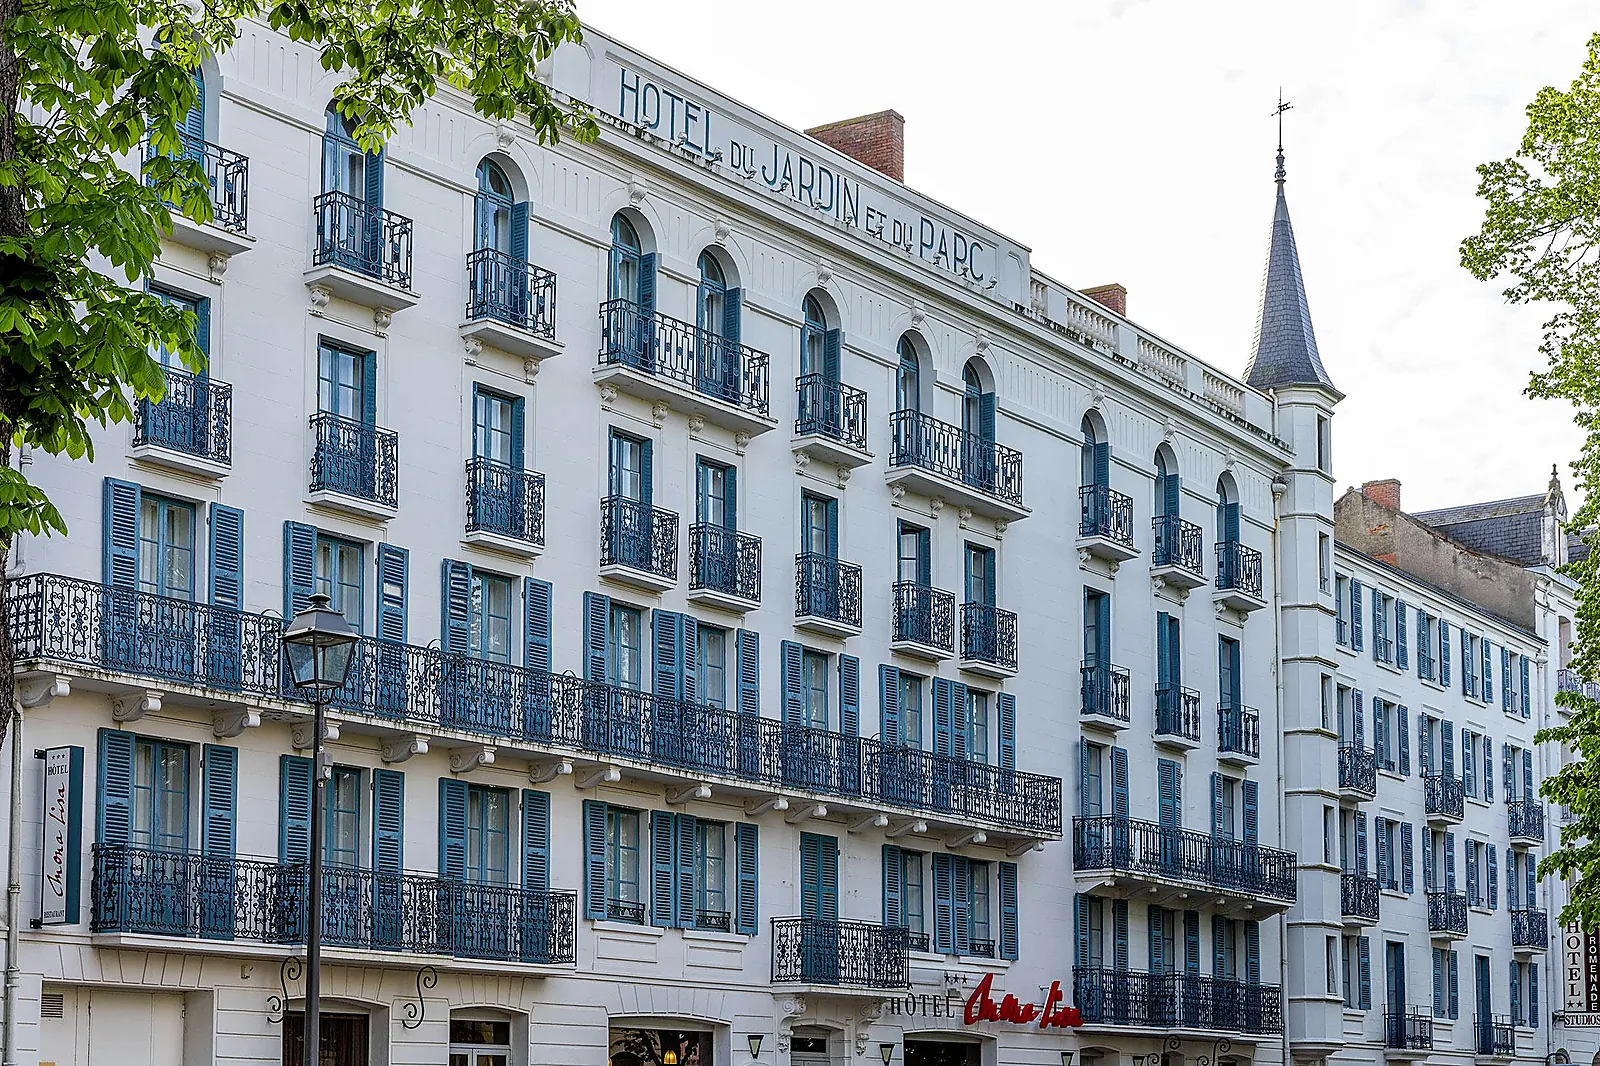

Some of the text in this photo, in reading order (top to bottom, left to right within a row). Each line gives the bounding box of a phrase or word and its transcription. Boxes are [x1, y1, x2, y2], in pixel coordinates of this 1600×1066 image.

[619, 67, 984, 283] HOTEL DU JARDIN ET DU PARC
[47, 763, 69, 776] HÔTEL
[48, 781, 66, 825] Lisa
[1565, 920, 1581, 997] HOTEL
[1588, 936, 1599, 1011] ROMENADE
[890, 984, 956, 1019] HÔTEL
